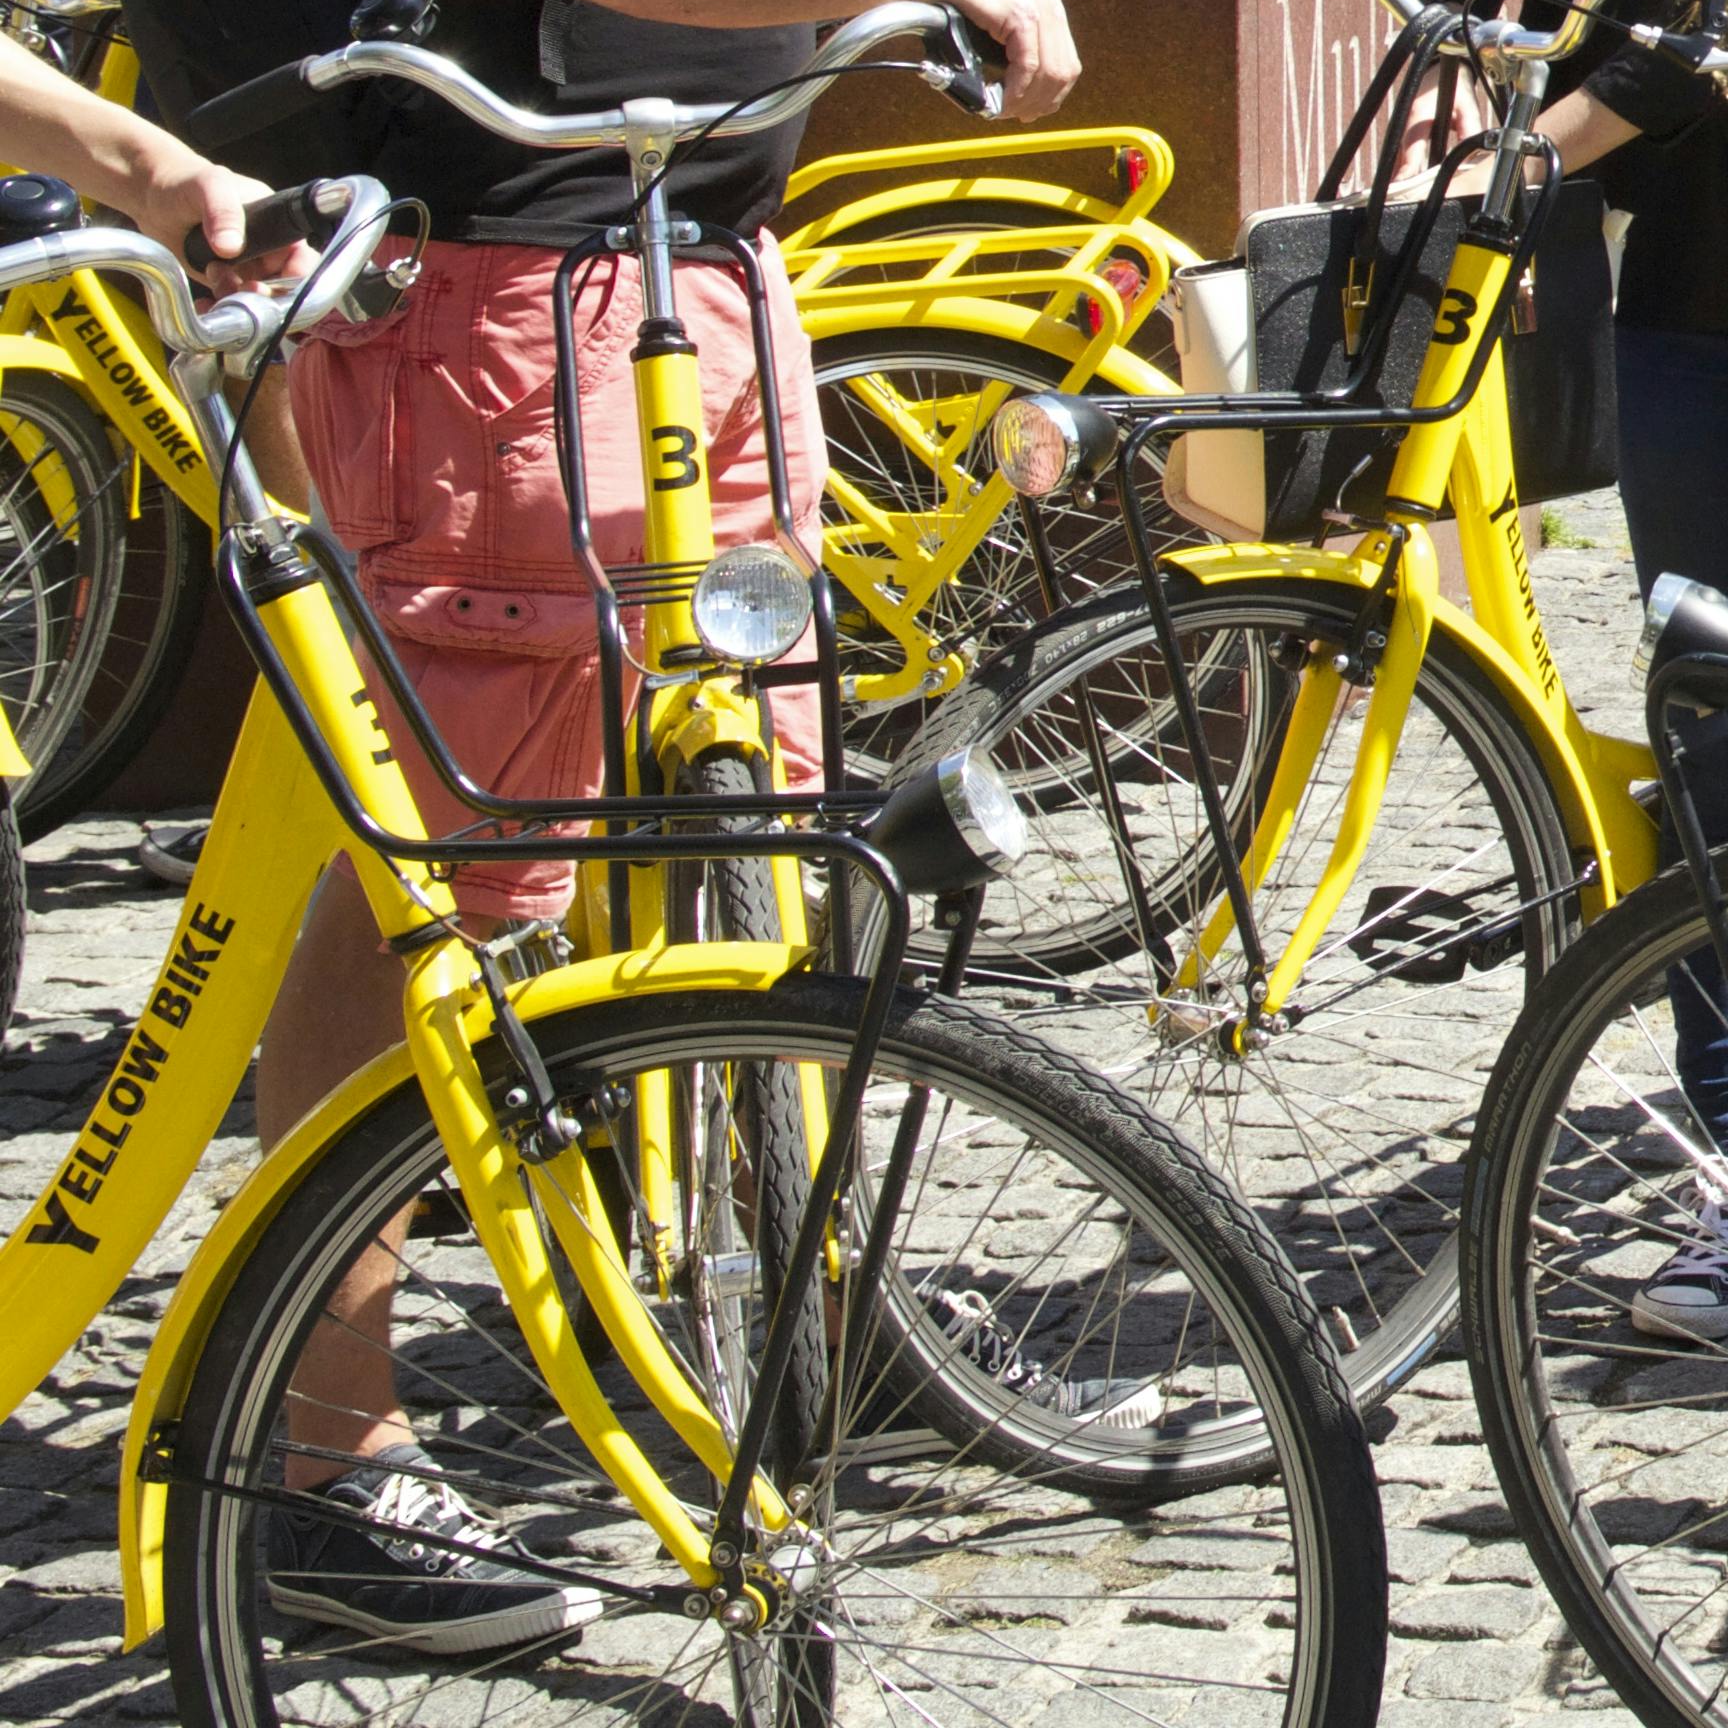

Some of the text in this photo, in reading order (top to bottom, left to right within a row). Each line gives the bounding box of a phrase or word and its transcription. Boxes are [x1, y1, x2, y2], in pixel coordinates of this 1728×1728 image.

[1432, 288, 1478, 345] 3
[55, 287, 203, 474] YELLOW BIKE
[651, 426, 700, 492] 3
[24, 902, 236, 1254] YELLOW BIKE
